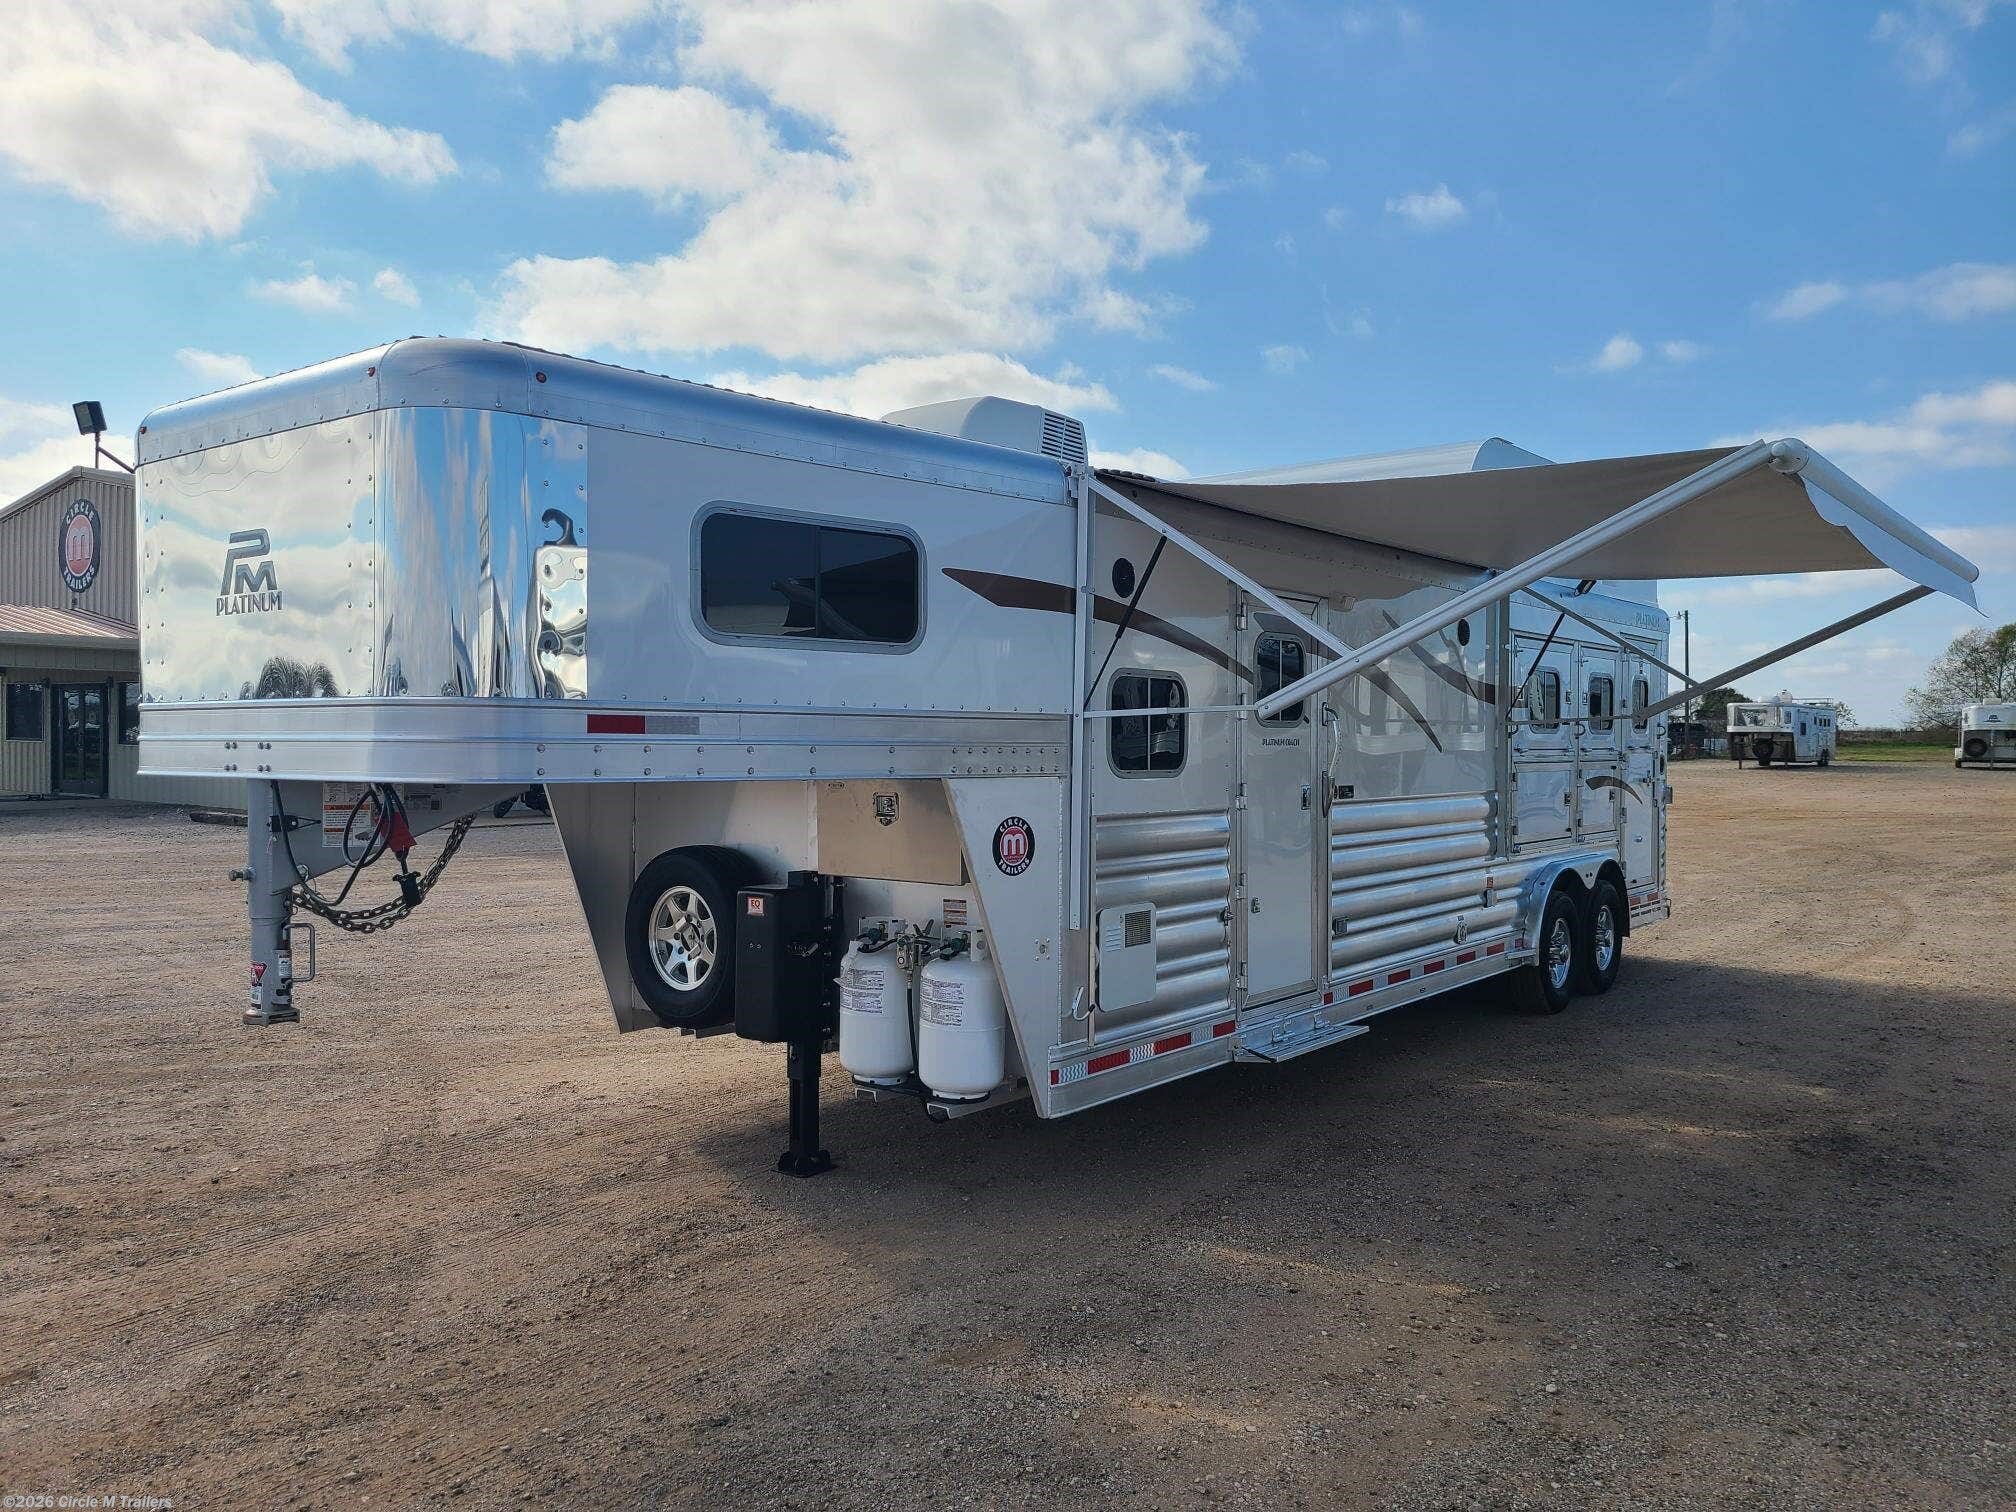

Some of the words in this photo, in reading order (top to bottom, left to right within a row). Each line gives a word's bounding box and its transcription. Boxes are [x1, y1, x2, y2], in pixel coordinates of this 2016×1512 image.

[66, 501, 95, 524] CIRCLE
[63, 566, 95, 589] TRAILERS
[216, 591, 282, 616] PLATINUM
[999, 818, 1028, 832] CIRCLE
[998, 857, 1030, 874] TRAILERS
